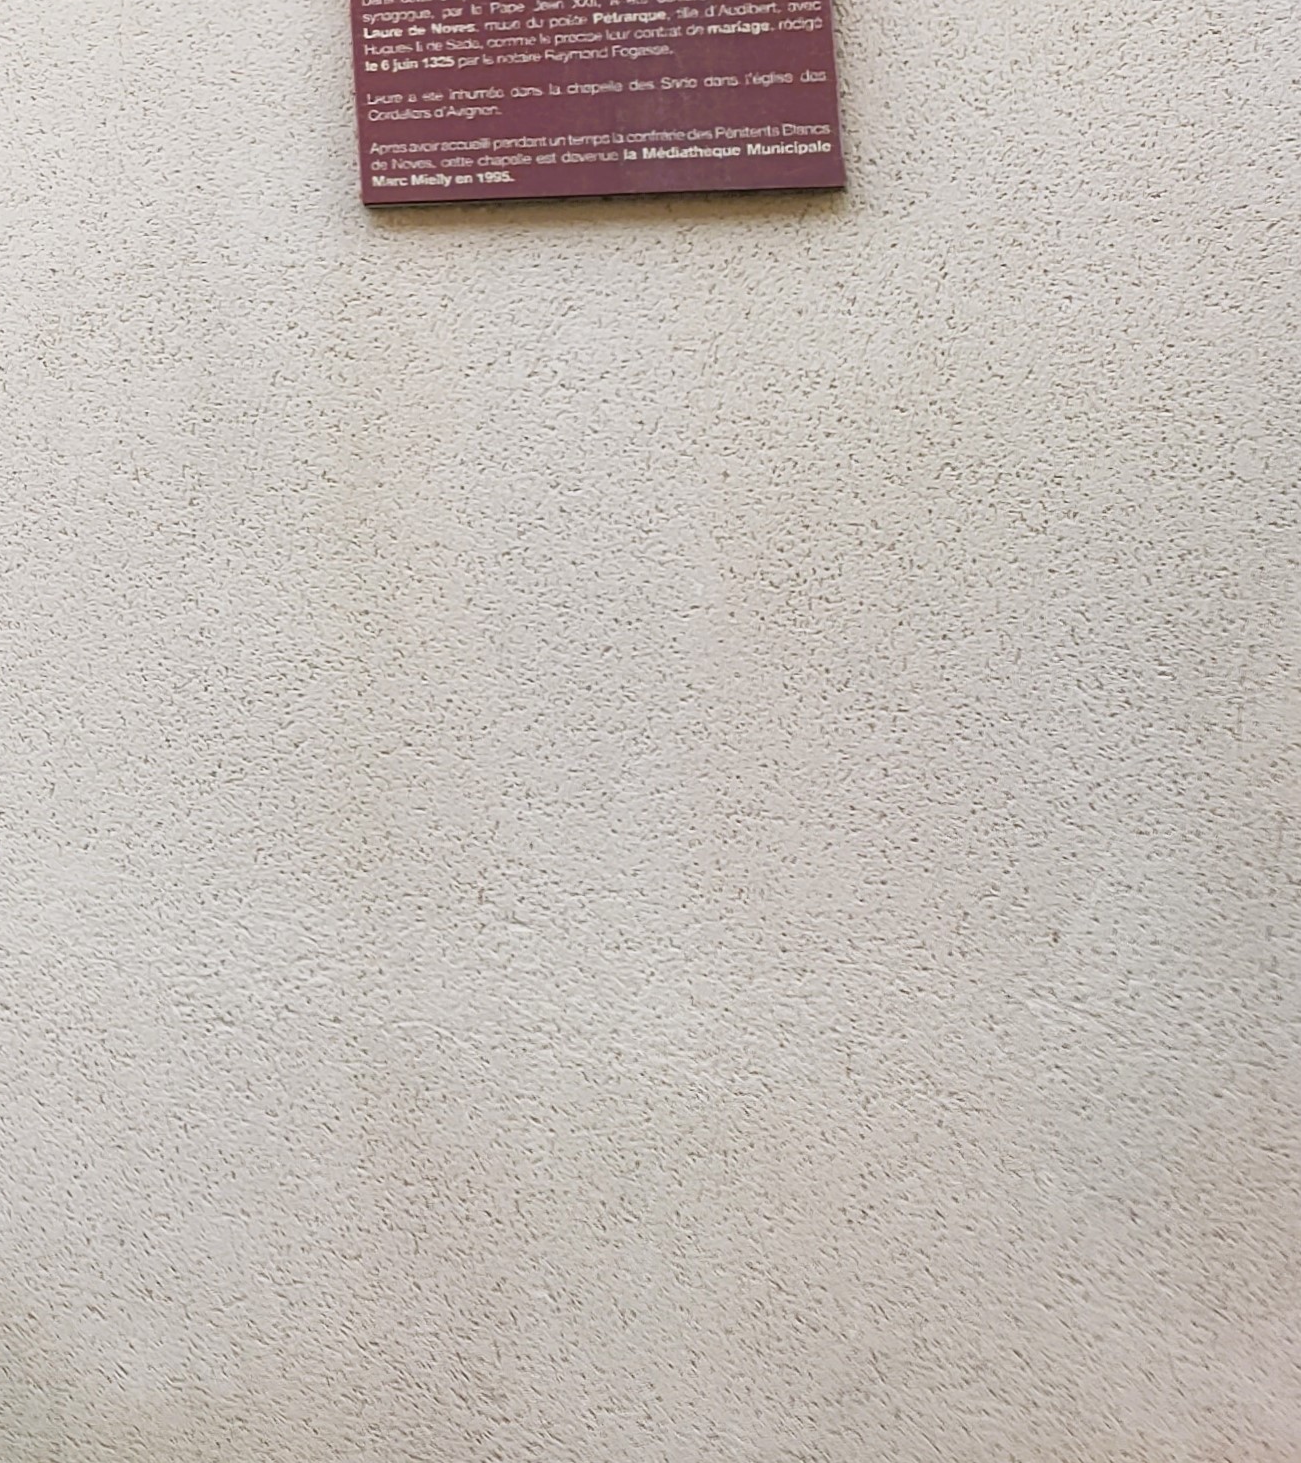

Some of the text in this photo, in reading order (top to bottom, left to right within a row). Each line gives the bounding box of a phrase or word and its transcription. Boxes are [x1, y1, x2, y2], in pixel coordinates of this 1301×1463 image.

[363, 27, 403, 39] Laure
[408, 24, 426, 35] de
[365, 60, 378, 73] le
[380, 59, 389, 71] 6
[392, 58, 419, 73] juin
[422, 56, 455, 68] 1325
[624, 148, 637, 160] la
[747, 140, 831, 156] Municipale
[372, 175, 408, 187] Marc
[455, 174, 473, 184] en
[476, 171, 515, 183] 1995.
